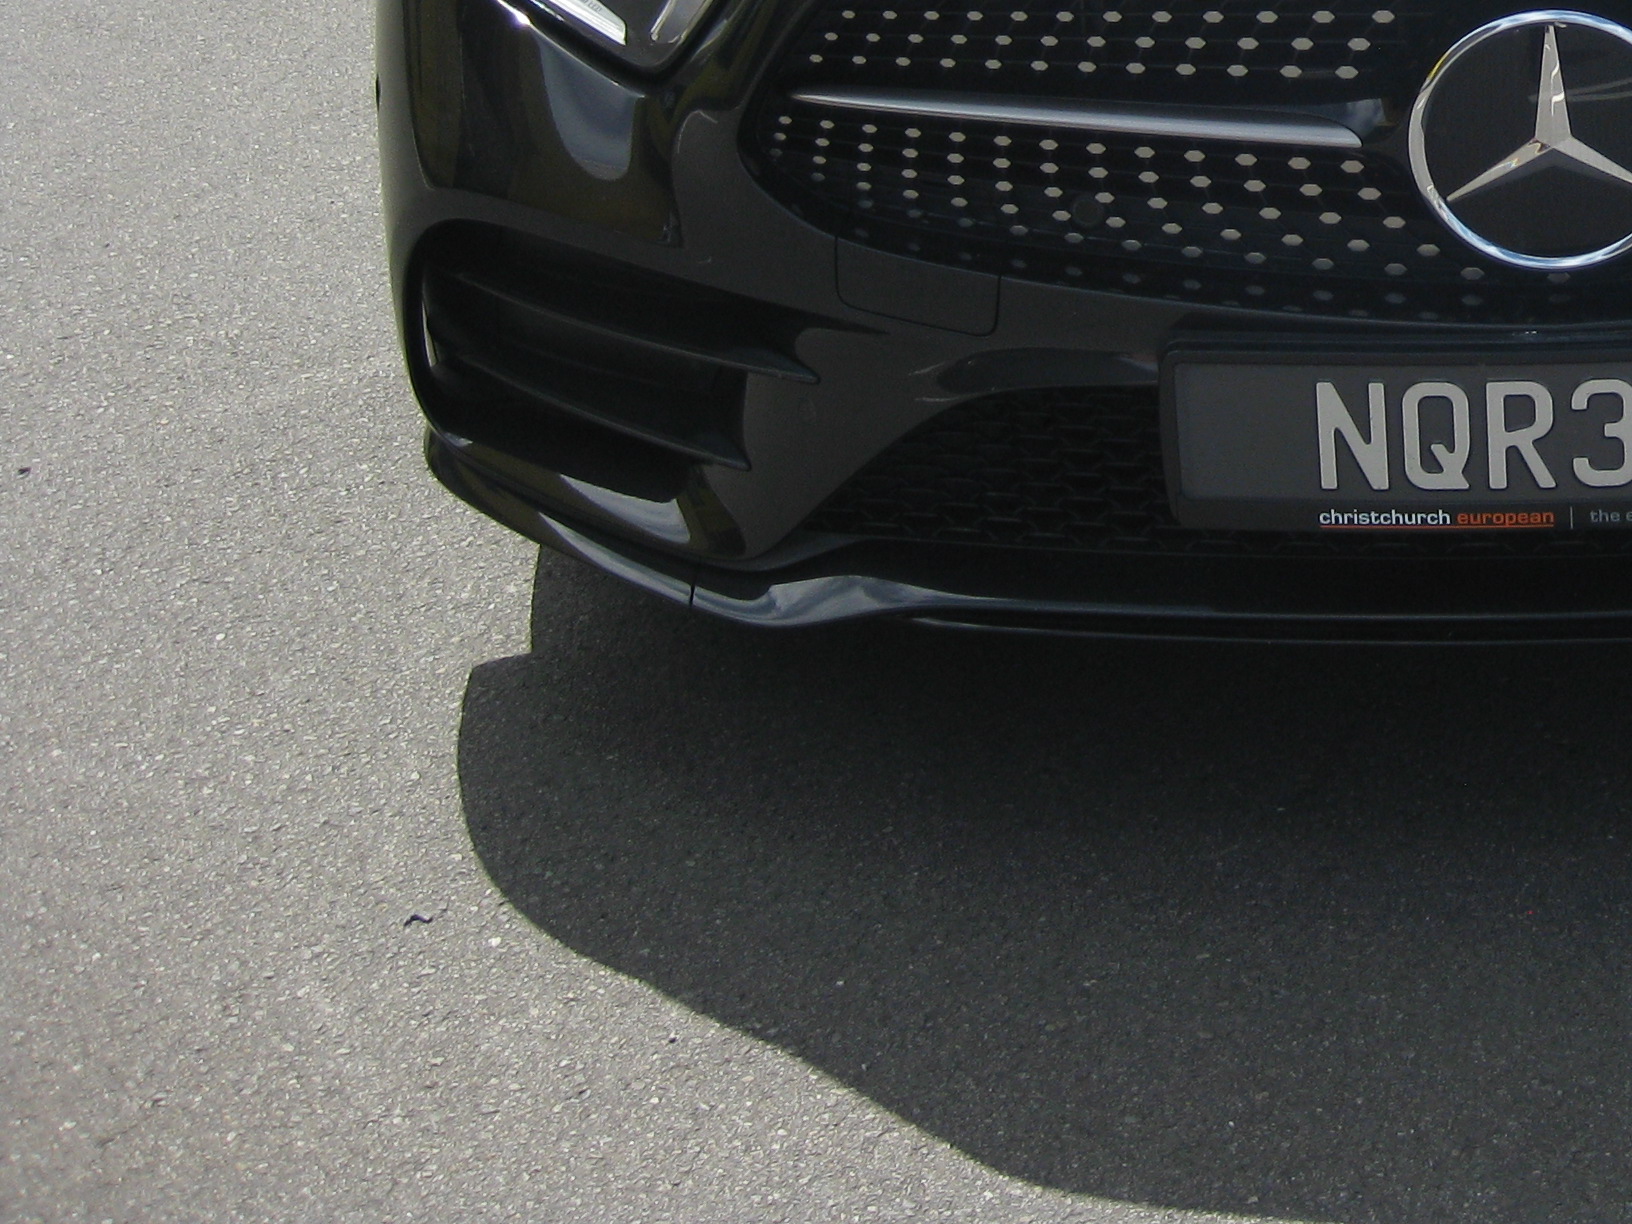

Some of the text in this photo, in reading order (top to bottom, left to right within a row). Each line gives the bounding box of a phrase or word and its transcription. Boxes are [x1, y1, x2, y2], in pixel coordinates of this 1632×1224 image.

[1319, 508, 1554, 526] christchurch european
[1589, 509, 1621, 523] the
